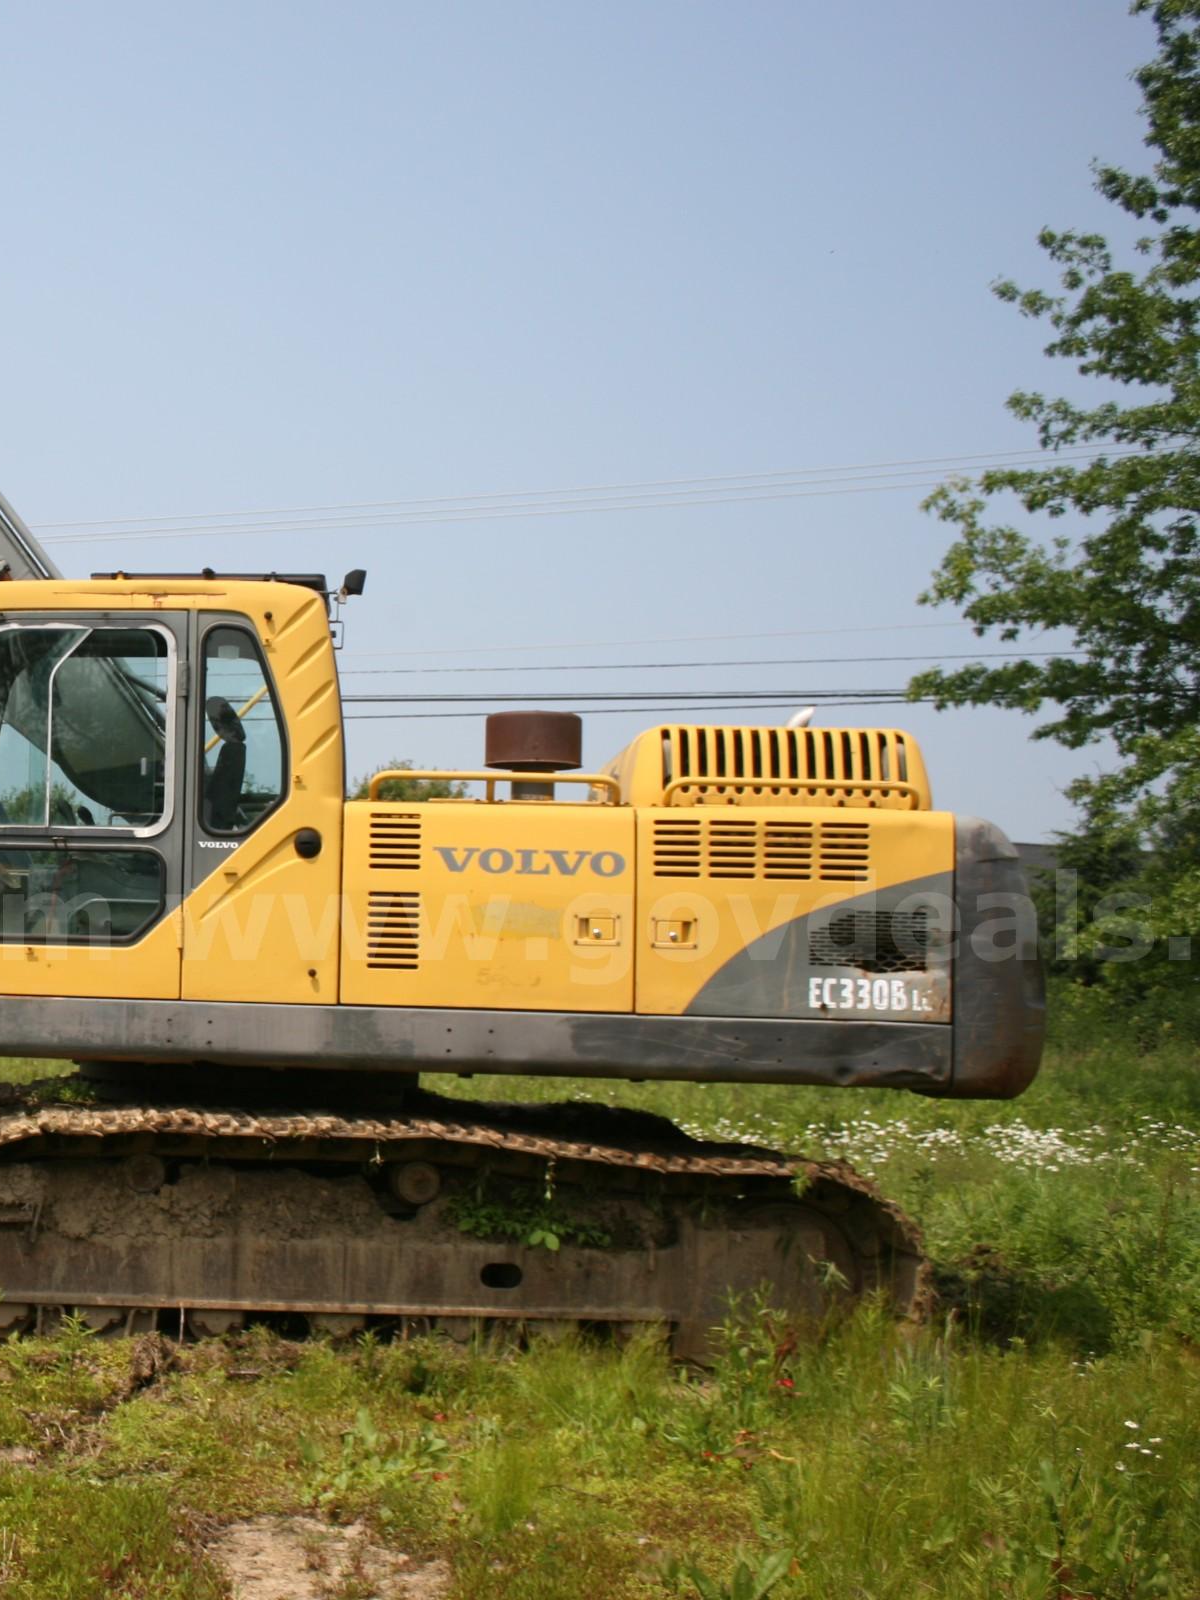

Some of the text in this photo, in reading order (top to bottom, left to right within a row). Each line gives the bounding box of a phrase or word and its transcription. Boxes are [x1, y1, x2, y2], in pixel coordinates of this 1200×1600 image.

[198, 841, 239, 849] VOLVO
[433, 846, 626, 877] VOLVO
[809, 977, 908, 1010] EC330B
